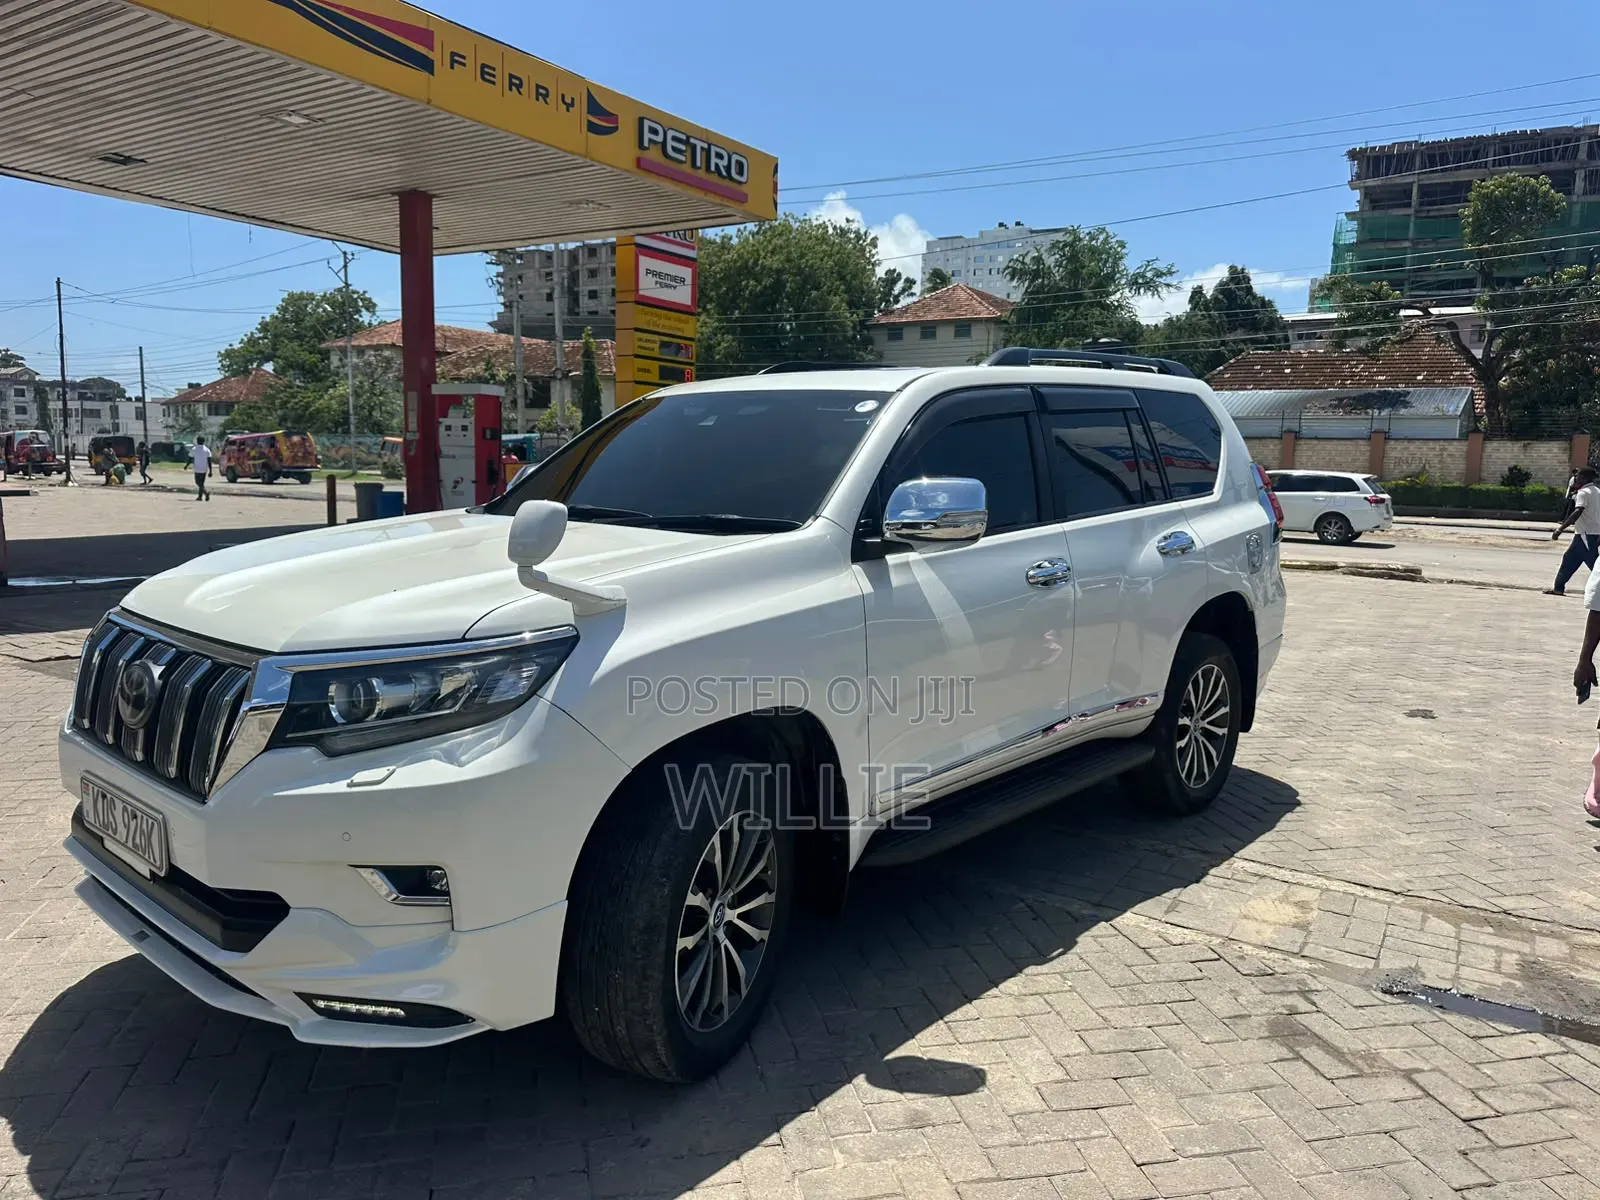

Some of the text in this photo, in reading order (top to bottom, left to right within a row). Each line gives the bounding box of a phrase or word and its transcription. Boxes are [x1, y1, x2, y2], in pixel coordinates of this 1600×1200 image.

[449, 51, 575, 112] FERRY
[638, 116, 749, 184] PETRO
[645, 268, 686, 285] PREMIER
[655, 280, 678, 290] FERRY
[92, 786, 158, 865] KDS 926K
